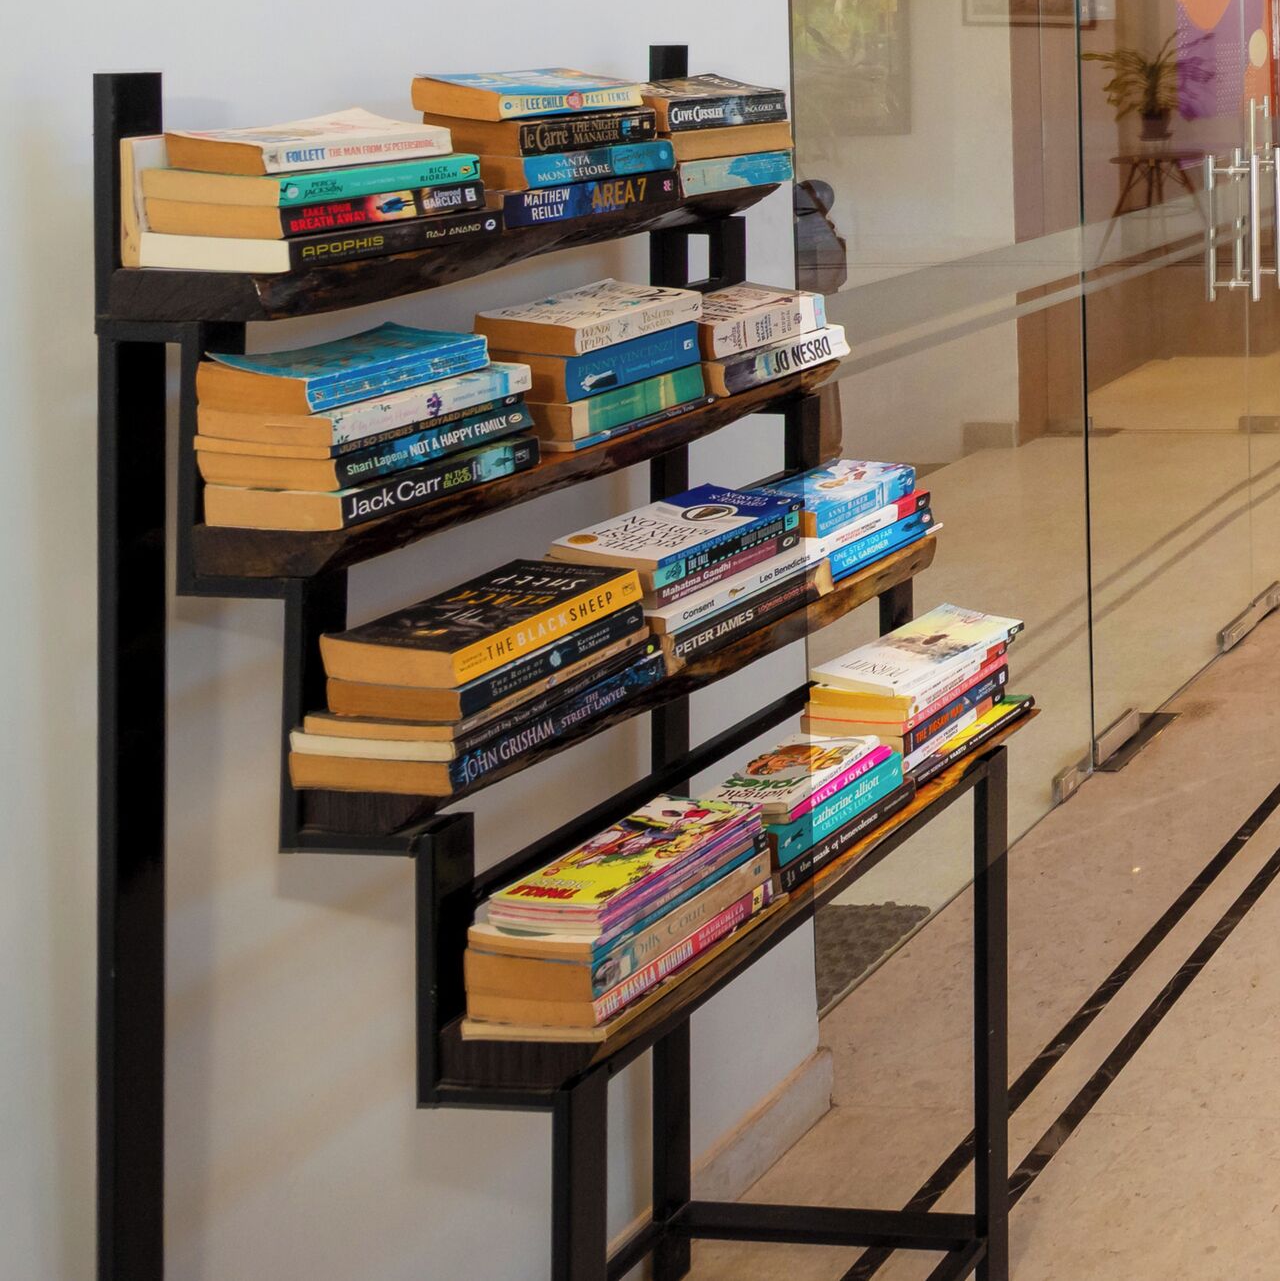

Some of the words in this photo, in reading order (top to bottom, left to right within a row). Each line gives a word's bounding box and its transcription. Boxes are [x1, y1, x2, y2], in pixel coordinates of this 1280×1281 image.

[525, 98, 541, 110] LEE
[542, 96, 564, 109] CHILD
[670, 107, 693, 124] CLIVE
[693, 105, 724, 122] CUSSLER
[571, 122, 590, 133] THE
[591, 119, 620, 131] NIGHT
[524, 126, 536, 149] le
[573, 129, 620, 145] MANAGER
[286, 147, 326, 164] FOLLETT
[328, 147, 342, 158] THE
[344, 146, 362, 156] MAN
[362, 144, 383, 155] FROM
[555, 154, 591, 168] SANTA
[419, 171, 458, 183] RIORDAN
[429, 165, 448, 174] RICK
[537, 163, 612, 182] MONTEFIORE
[303, 184, 344, 199] JACKSON
[523, 188, 570, 207] MATTHEW
[591, 180, 636, 209] AREA
[637, 177, 648, 202] 7
[303, 205, 326, 218] TAKE
[326, 202, 352, 214] YOUR
[423, 196, 462, 210] BARCLAY
[531, 204, 565, 221] REILLY
[290, 215, 336, 233] BREATH
[336, 210, 367, 225] AWAY
[425, 230, 446, 239] RAJ
[448, 223, 482, 236] ANAND
[302, 236, 385, 258] APOPHIS
[578, 357, 616, 377] PENNY
[773, 350, 790, 374] JO
[419, 412, 461, 431] RUDYARD
[339, 440, 362, 454] JUST
[364, 437, 378, 448] SO
[378, 426, 414, 444] STORIES
[409, 440, 430, 457] NOT
[432, 438, 440, 450] A
[440, 426, 474, 447] HAPPY
[474, 415, 508, 436] FAMILY
[346, 459, 372, 476] Shari
[374, 450, 408, 468] Lapena
[442, 474, 472, 490] BLOOD
[444, 472, 454, 481] IN
[454, 467, 470, 478] THE
[348, 486, 396, 519] Jack
[396, 476, 442, 502] Carr
[833, 551, 848, 562] ONE
[849, 542, 867, 555] STEP
[866, 534, 880, 546] TOO
[880, 528, 894, 540] FAR
[842, 554, 860, 568] LISA
[860, 539, 889, 558] GARDNER
[759, 572, 774, 584] Leo
[774, 554, 811, 578] Benedictus
[490, 574, 587, 591] SHEEP
[662, 576, 701, 599] Mahatma
[702, 560, 732, 579] Gandhi
[680, 575, 722, 598] AUTOBIOGRAPHY
[448, 590, 556, 607] BLACK
[682, 599, 715, 620] Consent
[486, 636, 515, 660] THE
[516, 613, 568, 648] BLACK
[569, 590, 614, 622] SHEEP
[675, 628, 714, 658] PETER
[714, 608, 754, 638] JAMES
[490, 677, 508, 690] THE
[510, 666, 532, 679] ROSE
[533, 658, 544, 668] OF
[560, 705, 593, 729] STREET
[594, 686, 628, 710] LAWYER
[584, 690, 600, 705] THE
[915, 730, 928, 744] THE
[460, 749, 499, 786] JOHN
[500, 720, 555, 761] GRISHAM
[810, 784, 839, 807] SILLY
[843, 759, 875, 786] JOKES
[854, 792, 874, 809] LUCK
[800, 860, 812, 872] the
[812, 845, 831, 864] mask
[831, 840, 840, 850] of
[840, 812, 879, 844] benevolence
[667, 902, 706, 936] Court
[600, 994, 620, 1015] THE
[622, 968, 657, 1002] MASALA
[658, 940, 694, 976] MURDER
